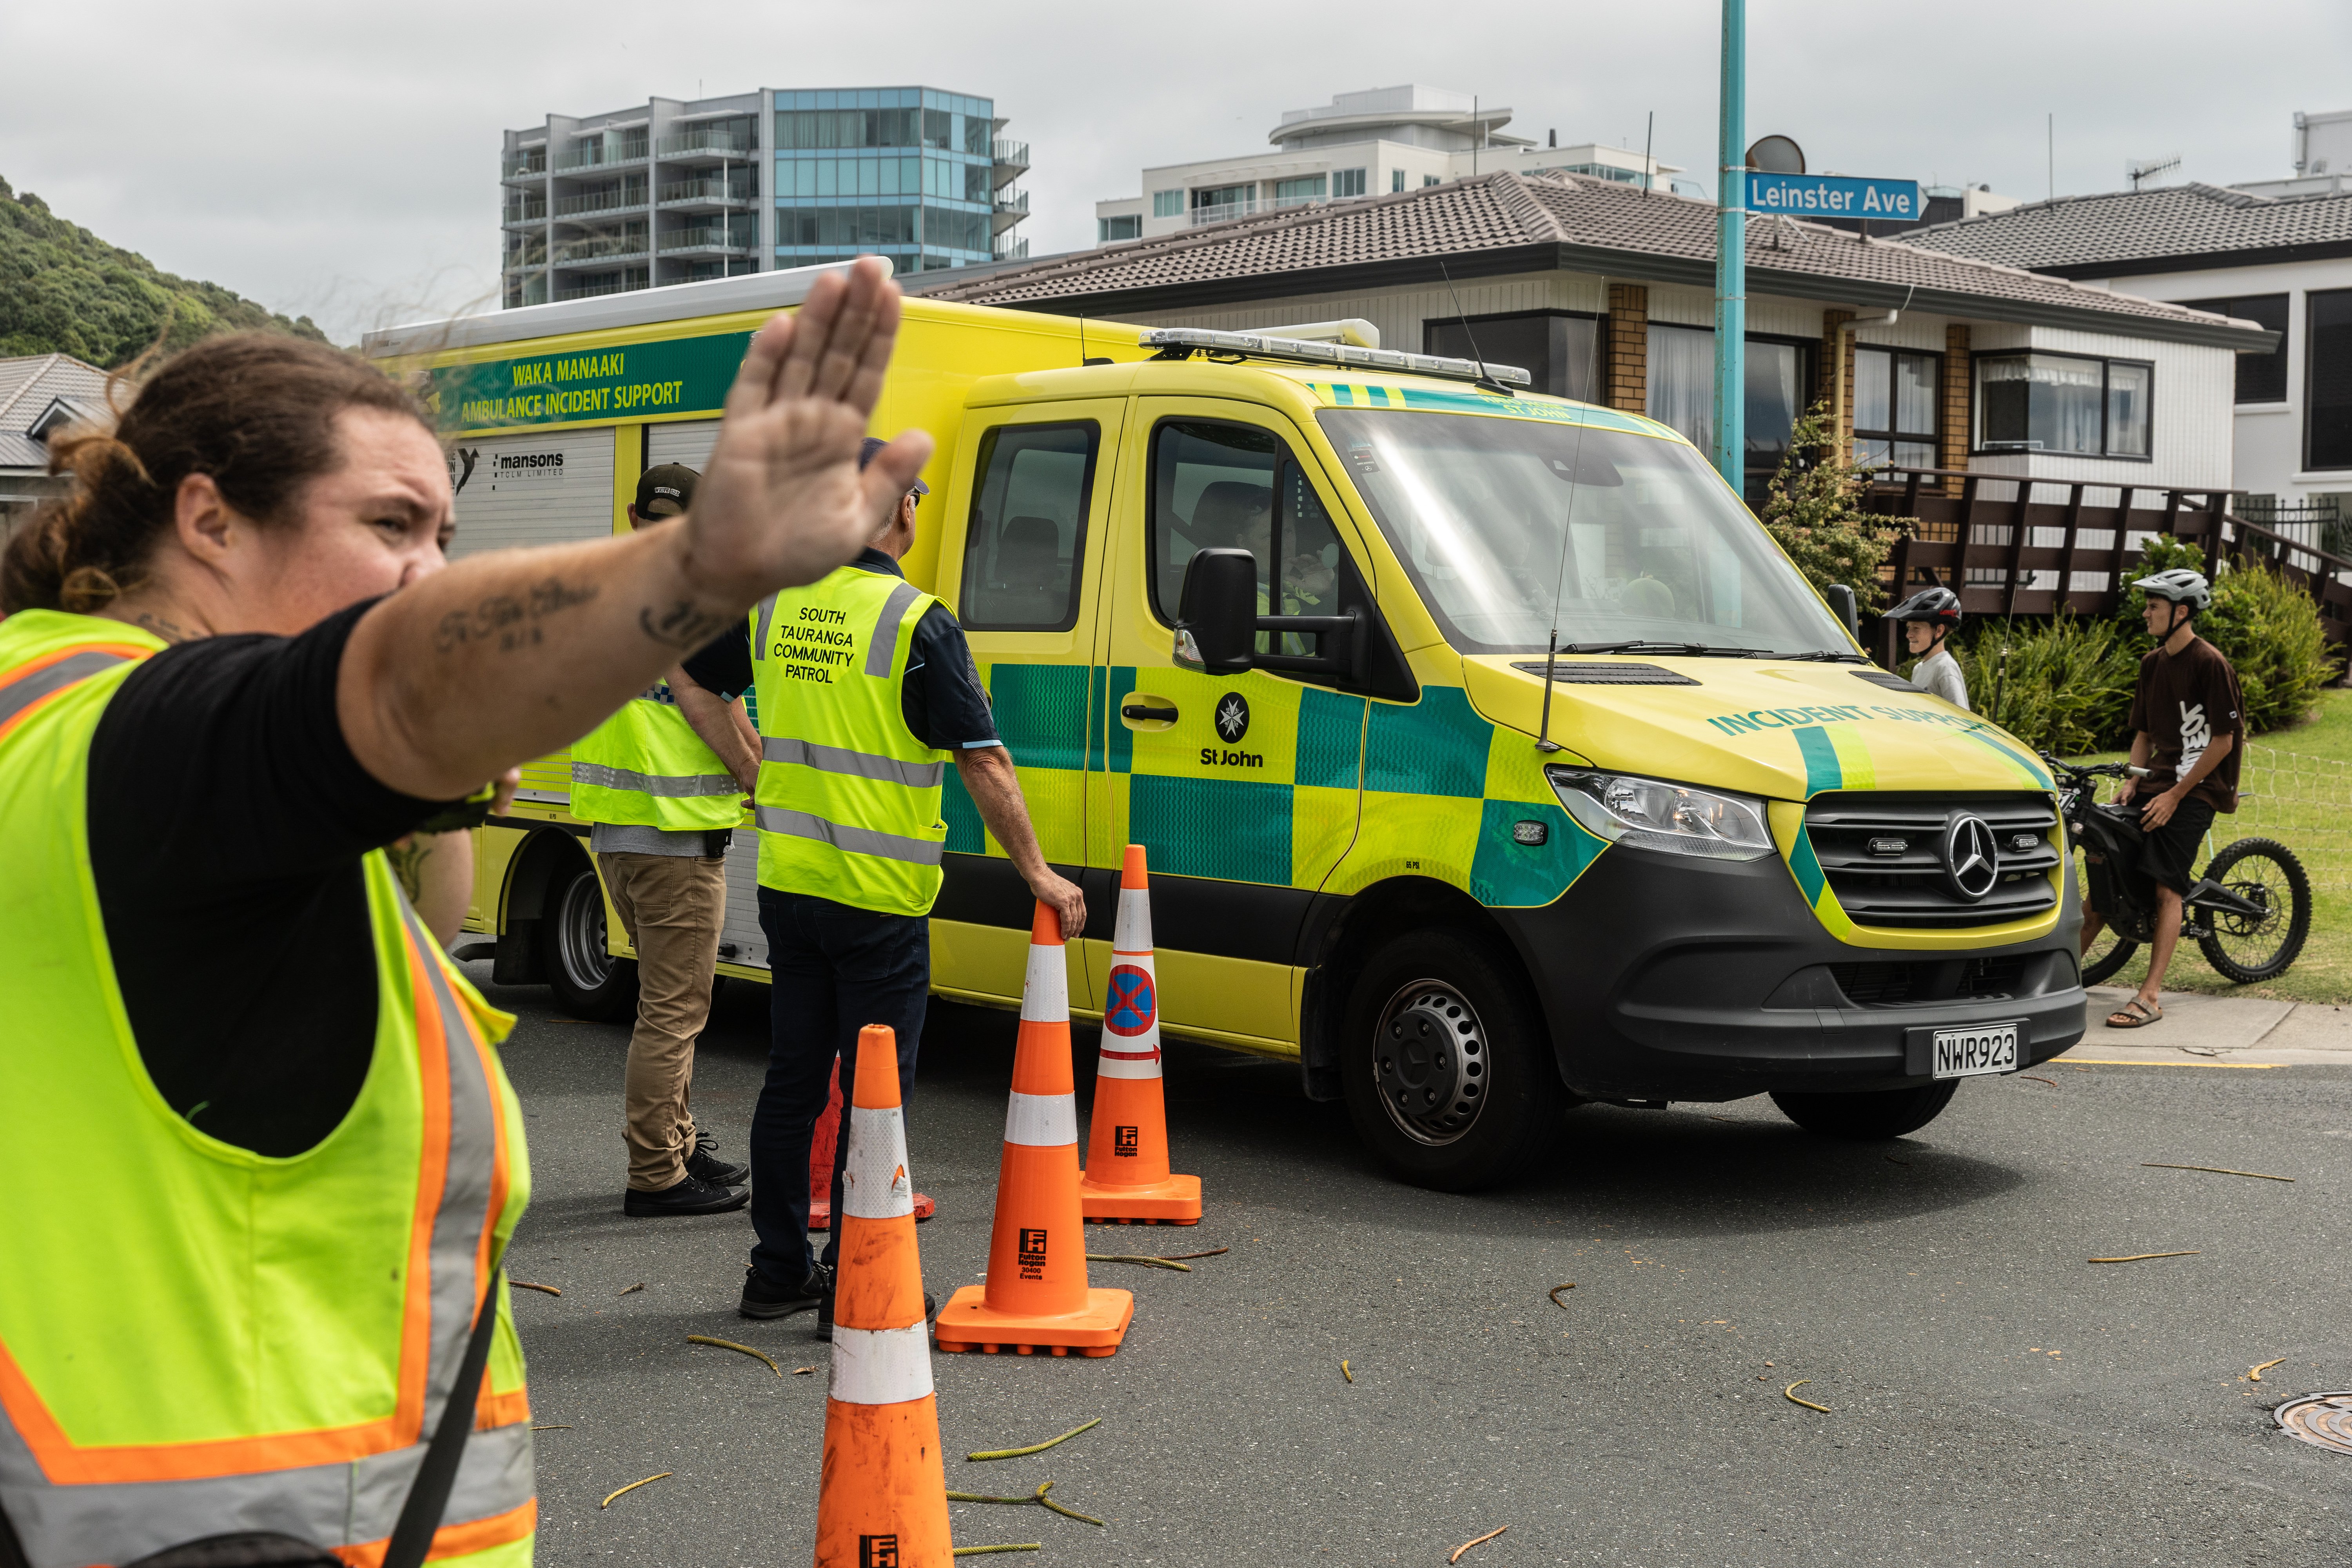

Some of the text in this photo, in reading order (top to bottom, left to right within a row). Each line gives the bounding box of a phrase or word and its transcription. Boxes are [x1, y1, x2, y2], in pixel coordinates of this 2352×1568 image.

[1752, 179, 1911, 214] Leinster Ave
[512, 353, 624, 386] WAKA MANAAKI
[460, 380, 683, 423] AMBULANCE INCIDENT SUPPORT
[1503, 405, 1572, 420] ST JOHN
[501, 453, 564, 469] mansons
[528, 469, 563, 477] LIMITED
[670, 488, 680, 497] SOX
[799, 607, 846, 625] SOUTH
[781, 625, 853, 647] TAURANGA
[774, 643, 855, 667] COMMUNITY
[785, 664, 833, 684] PATROL
[1706, 706, 2008, 739] INCIDENT SUPPORT
[1200, 748, 1263, 768] St John
[1938, 1033, 2014, 1071] NWR923
